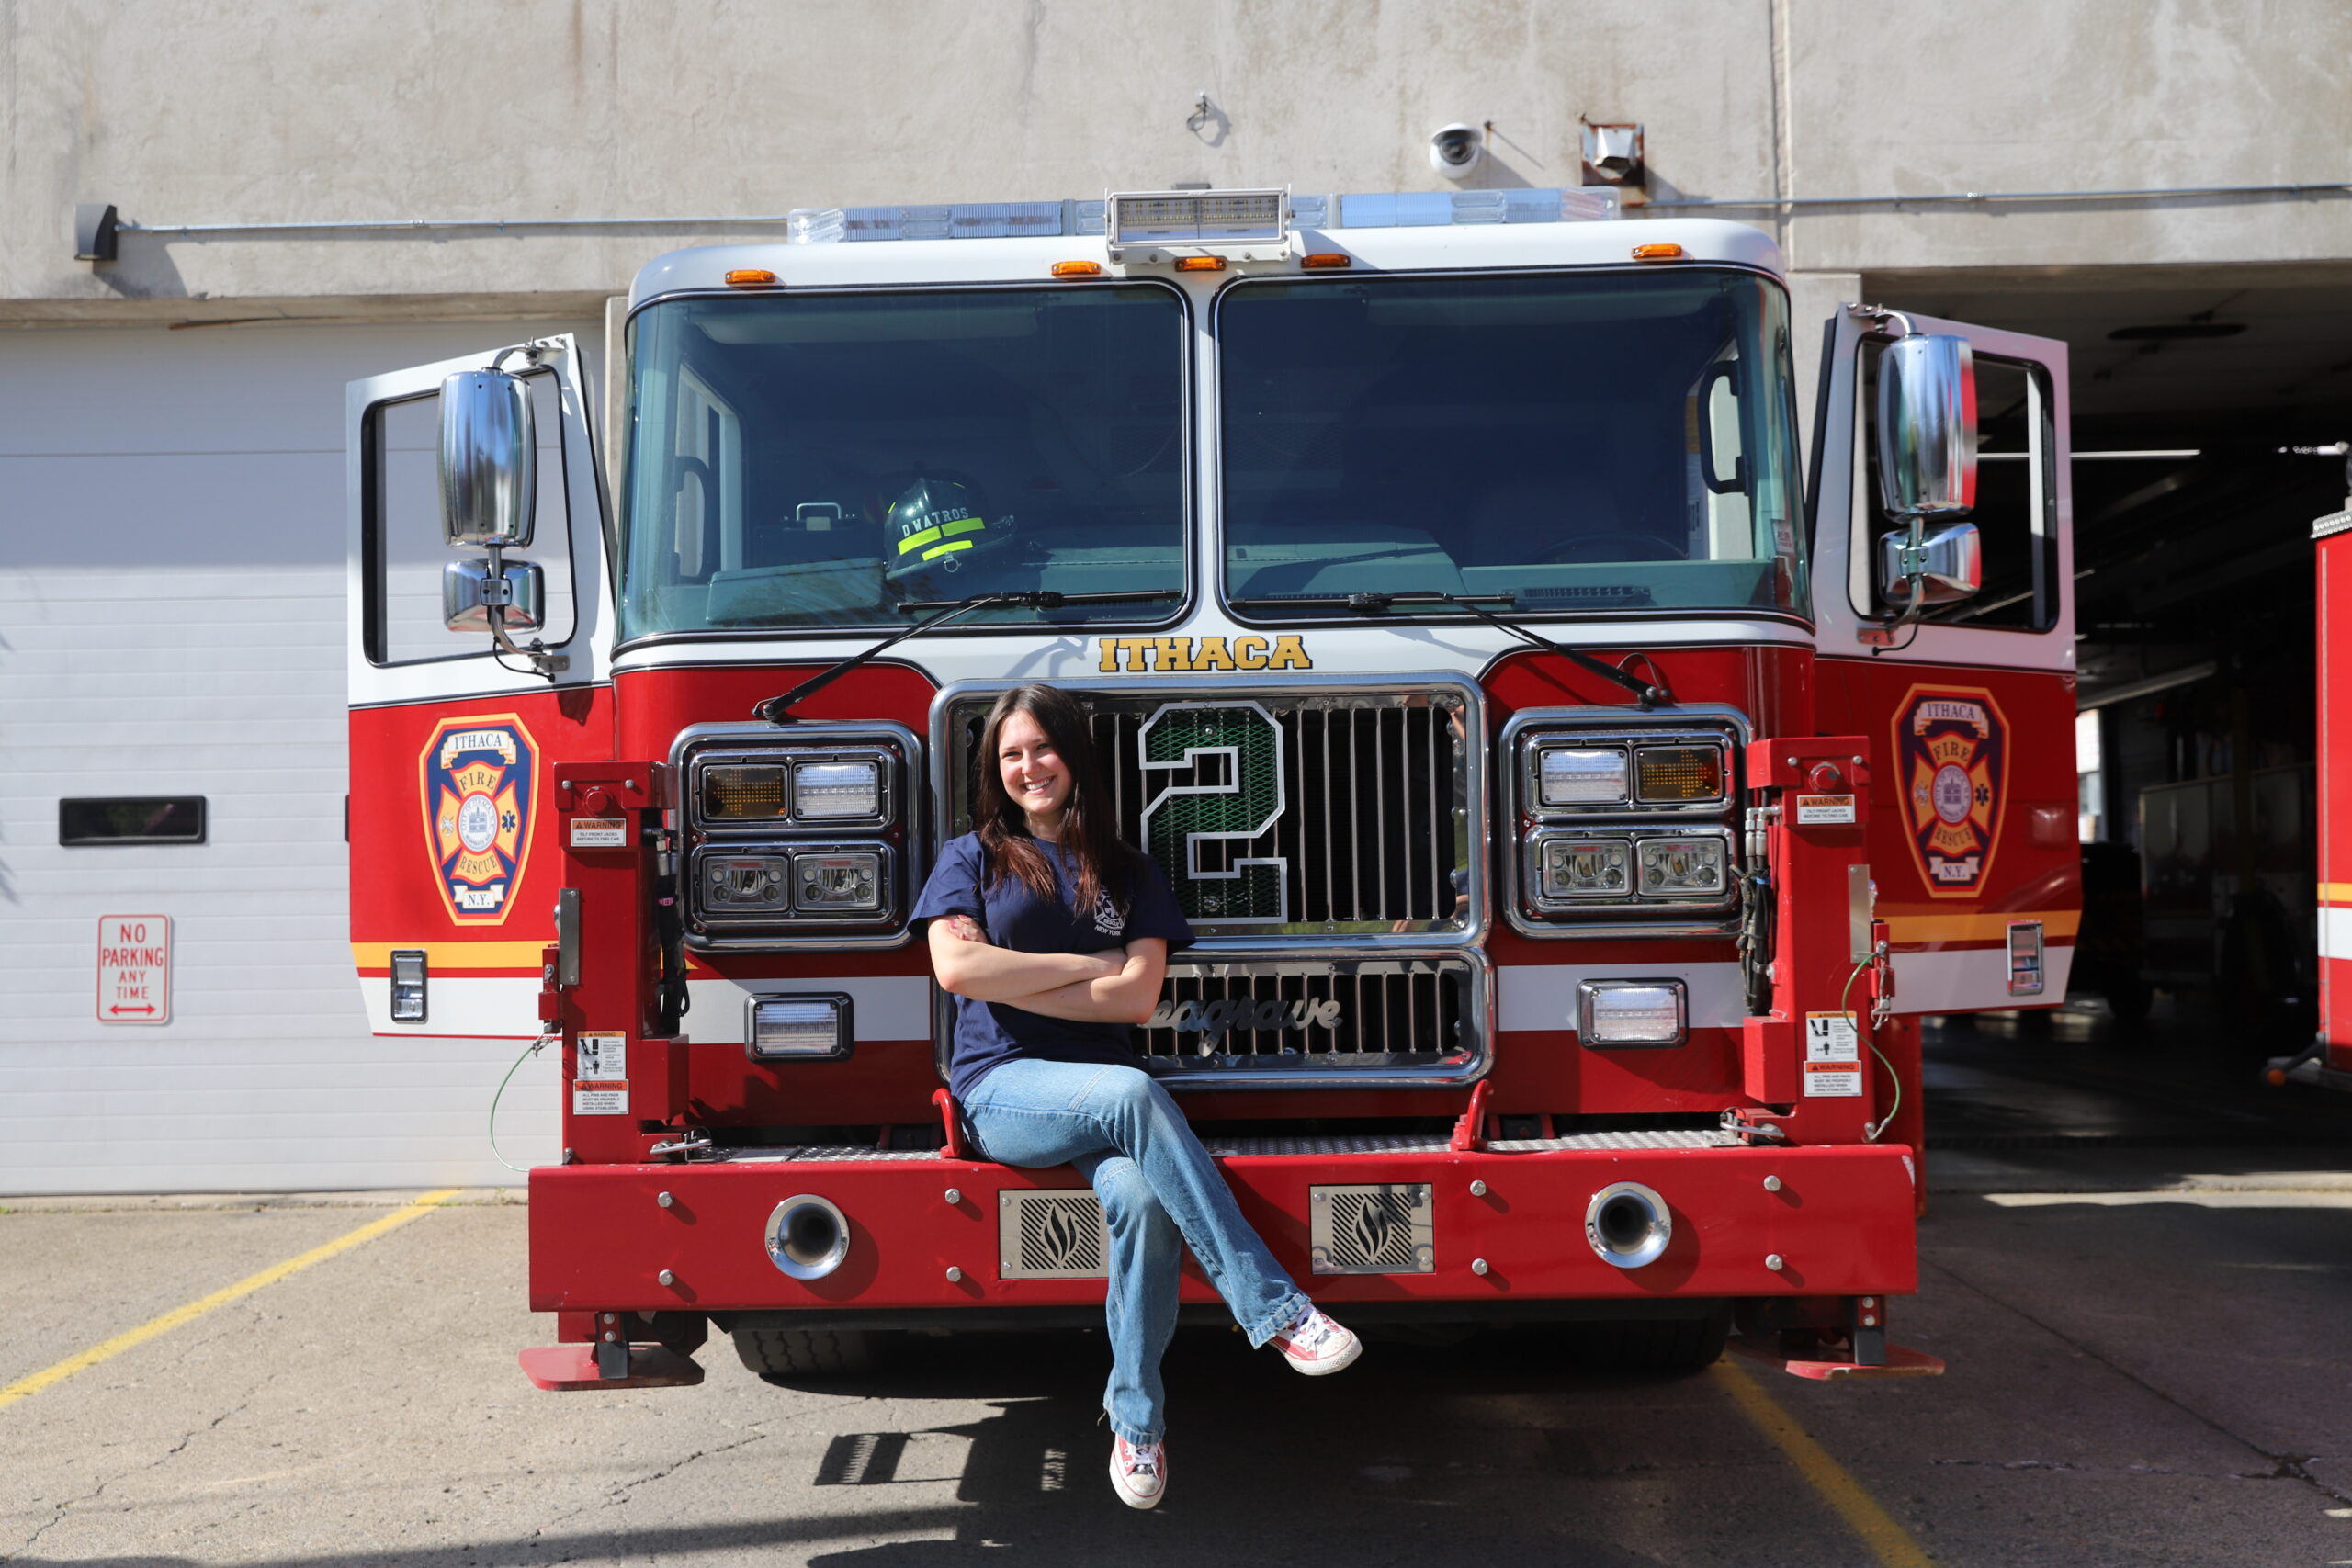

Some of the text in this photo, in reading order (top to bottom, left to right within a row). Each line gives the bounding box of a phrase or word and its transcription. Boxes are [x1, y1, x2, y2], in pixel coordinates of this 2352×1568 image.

[902, 507, 969, 537] D WATROS
[1099, 635, 1313, 672] ITHACA
[1927, 703, 1975, 719] ITHACA
[454, 733, 503, 750] ITHACA
[1933, 741, 1970, 761] FIRE
[459, 771, 497, 791] FIRE
[1138, 700, 1288, 926] 2
[1935, 826, 1973, 846] RESCUE
[459, 854, 497, 875] RESCUE
[1943, 865, 1966, 878] N.Y.
[468, 894, 491, 906] N.Y.
[120, 923, 146, 943] NO
[1094, 924, 1109, 934] NEW
[102, 947, 164, 967] PARKING
[119, 970, 147, 983] ANY
[117, 986, 149, 1000] TIME
[1137, 988, 1343, 1057] eagrave
